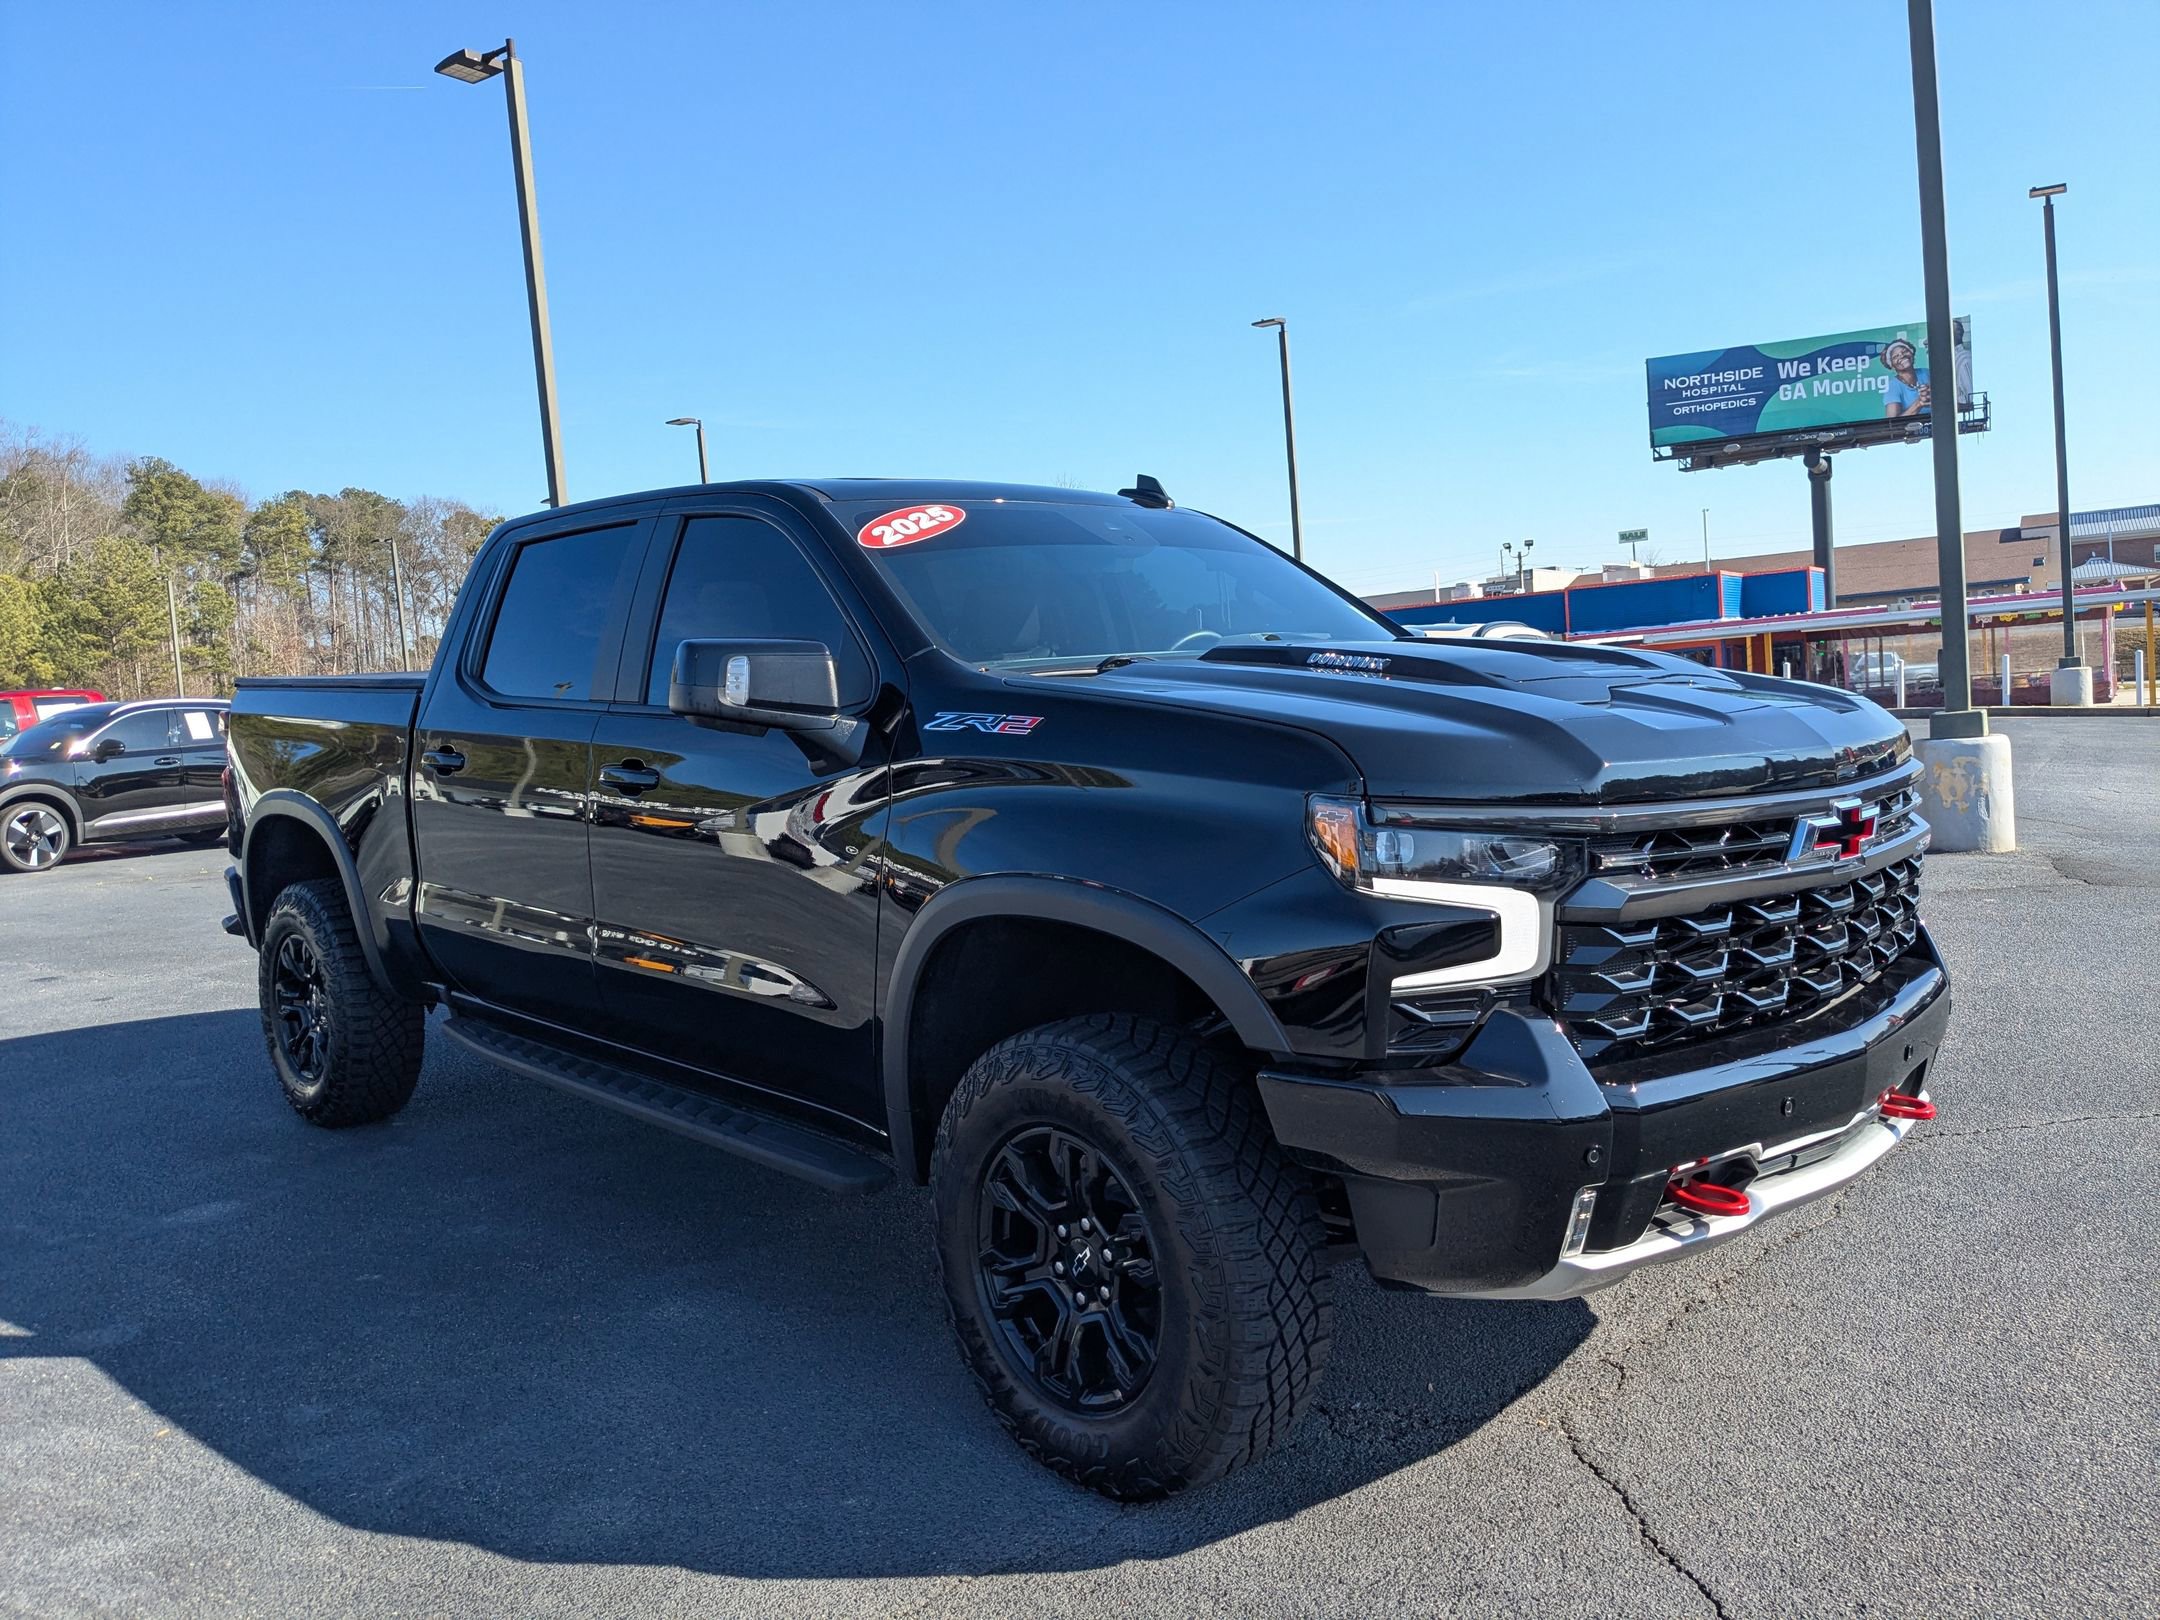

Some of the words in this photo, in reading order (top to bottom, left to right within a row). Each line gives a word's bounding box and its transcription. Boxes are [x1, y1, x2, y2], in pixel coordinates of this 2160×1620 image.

[1664, 367, 1763, 390] NORTHSIDE
[1777, 360, 1811, 379] We
[1817, 353, 1870, 375] Keep
[1682, 383, 1745, 398] HOSPITAL
[1779, 383, 1808, 402] GA
[1812, 374, 1890, 397] Moving
[1673, 398, 1757, 416] ORTHOPEDICS
[871, 506, 955, 546] 2025
[923, 711, 1047, 736] ZR2
